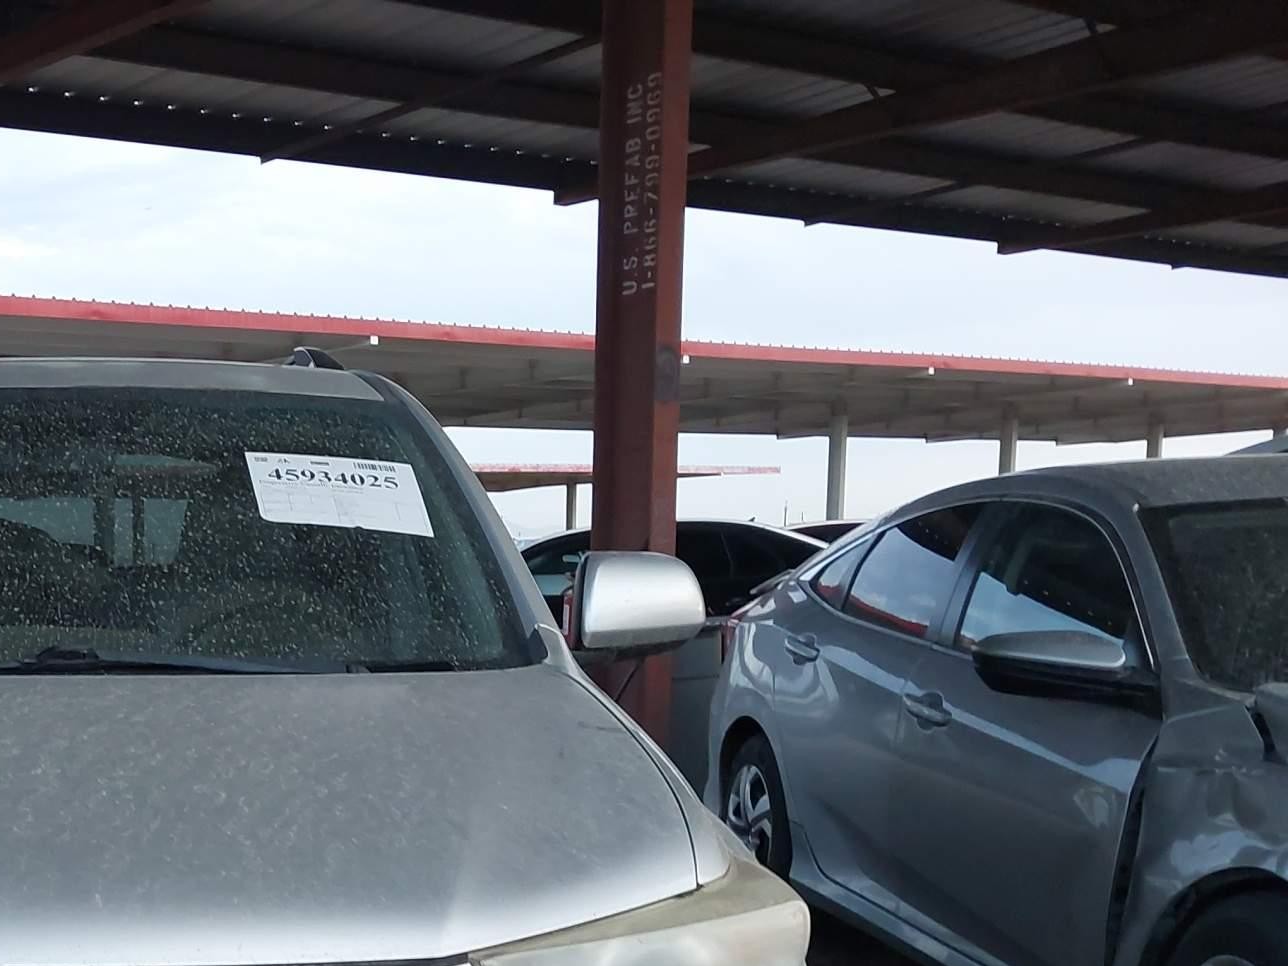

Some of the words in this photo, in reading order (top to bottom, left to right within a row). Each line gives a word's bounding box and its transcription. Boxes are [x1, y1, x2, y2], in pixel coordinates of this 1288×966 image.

[627, 84, 642, 124] INC
[624, 138, 641, 234] PREFAB
[623, 248, 638, 295] U.S.
[268, 468, 398, 489] 45934025
